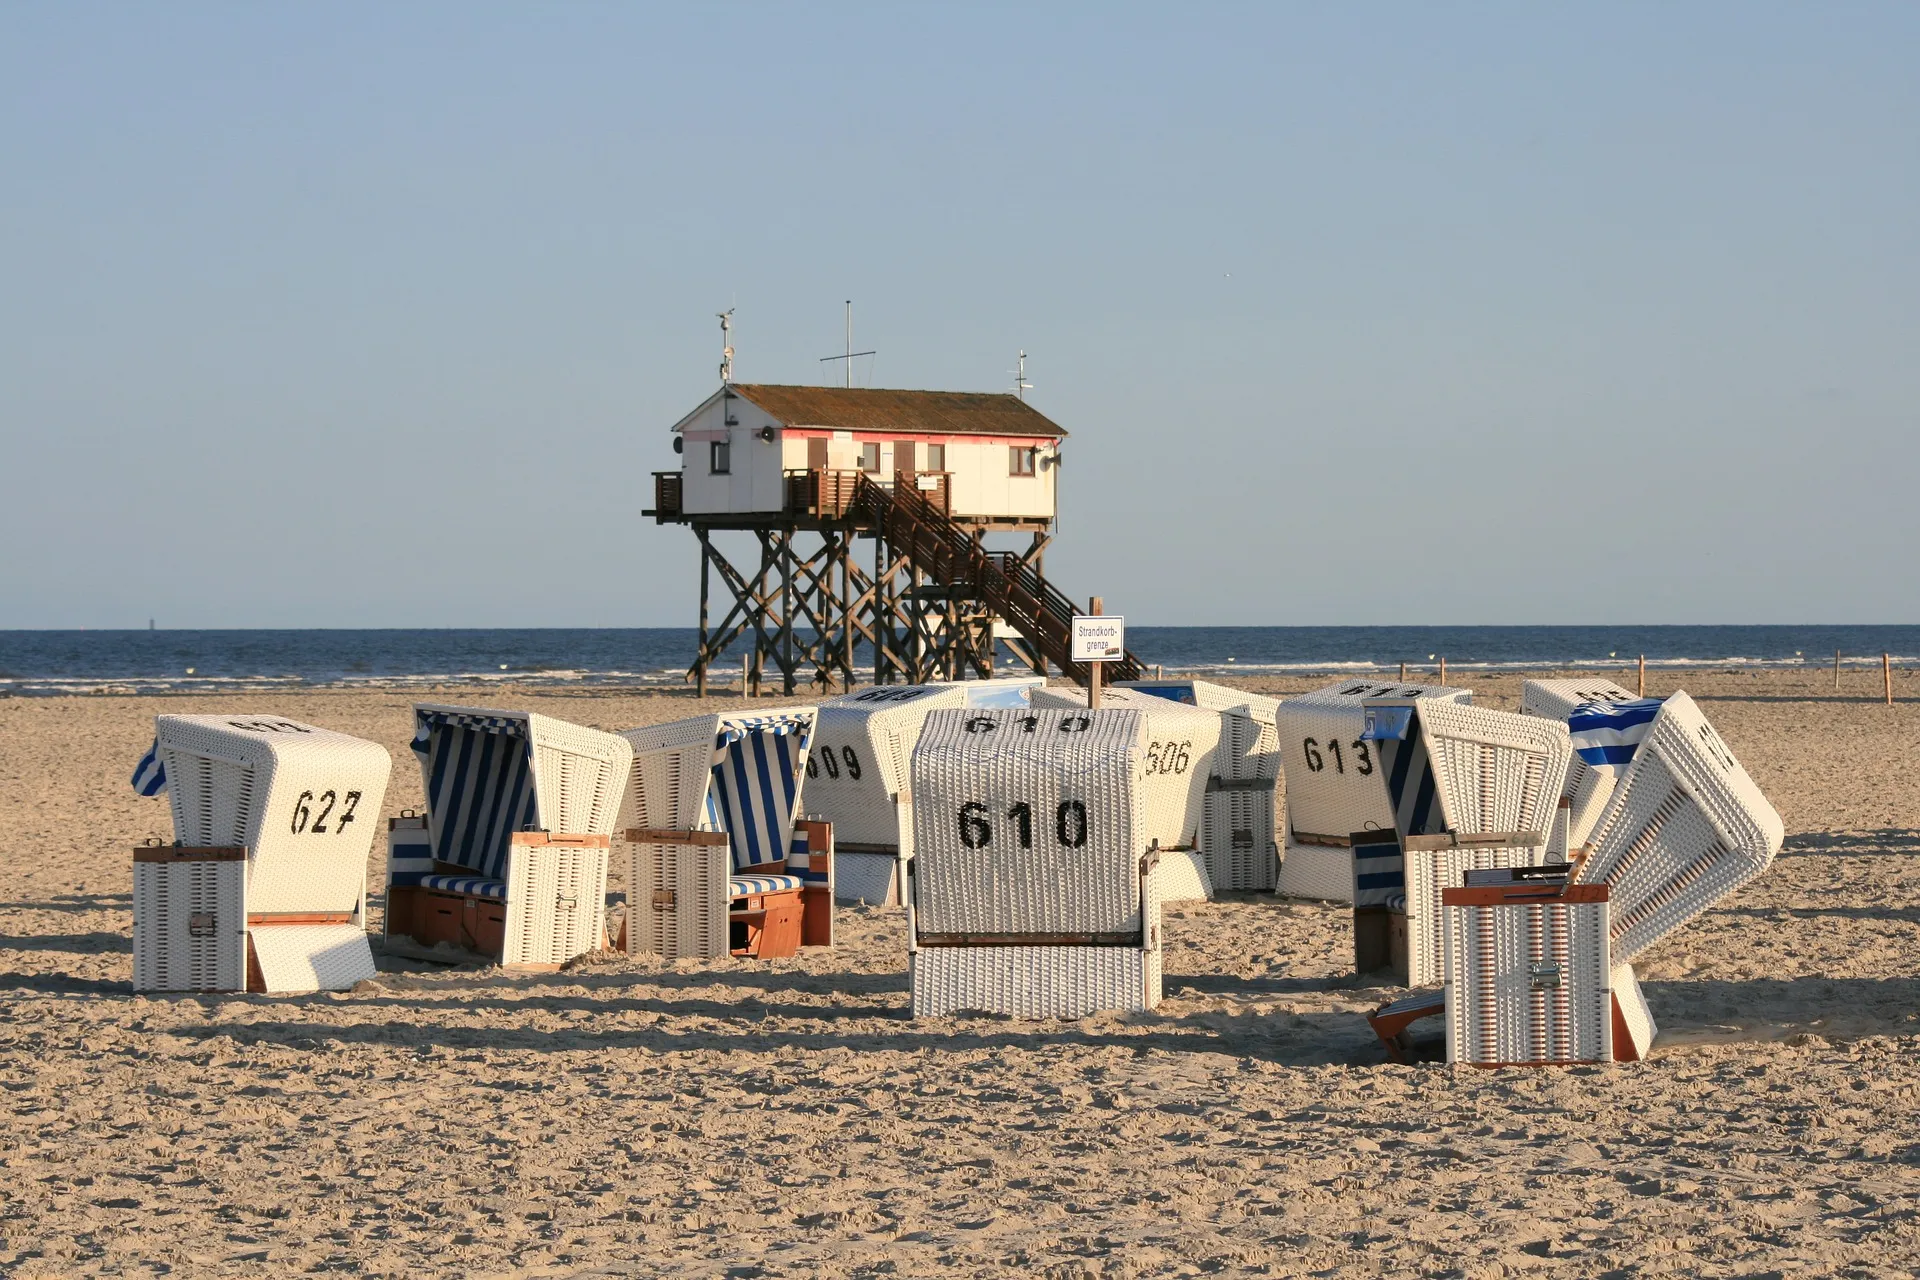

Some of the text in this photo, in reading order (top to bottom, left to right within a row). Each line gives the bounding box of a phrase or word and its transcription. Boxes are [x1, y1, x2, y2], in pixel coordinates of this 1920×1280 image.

[1078, 625, 1118, 637] Strandkorb-
[1086, 641, 1109, 653] grenze
[965, 716, 1090, 733] 610
[1145, 740, 1191, 776] 606
[1303, 737, 1373, 775] 613
[290, 789, 363, 835] 627
[957, 799, 1088, 850] 610
